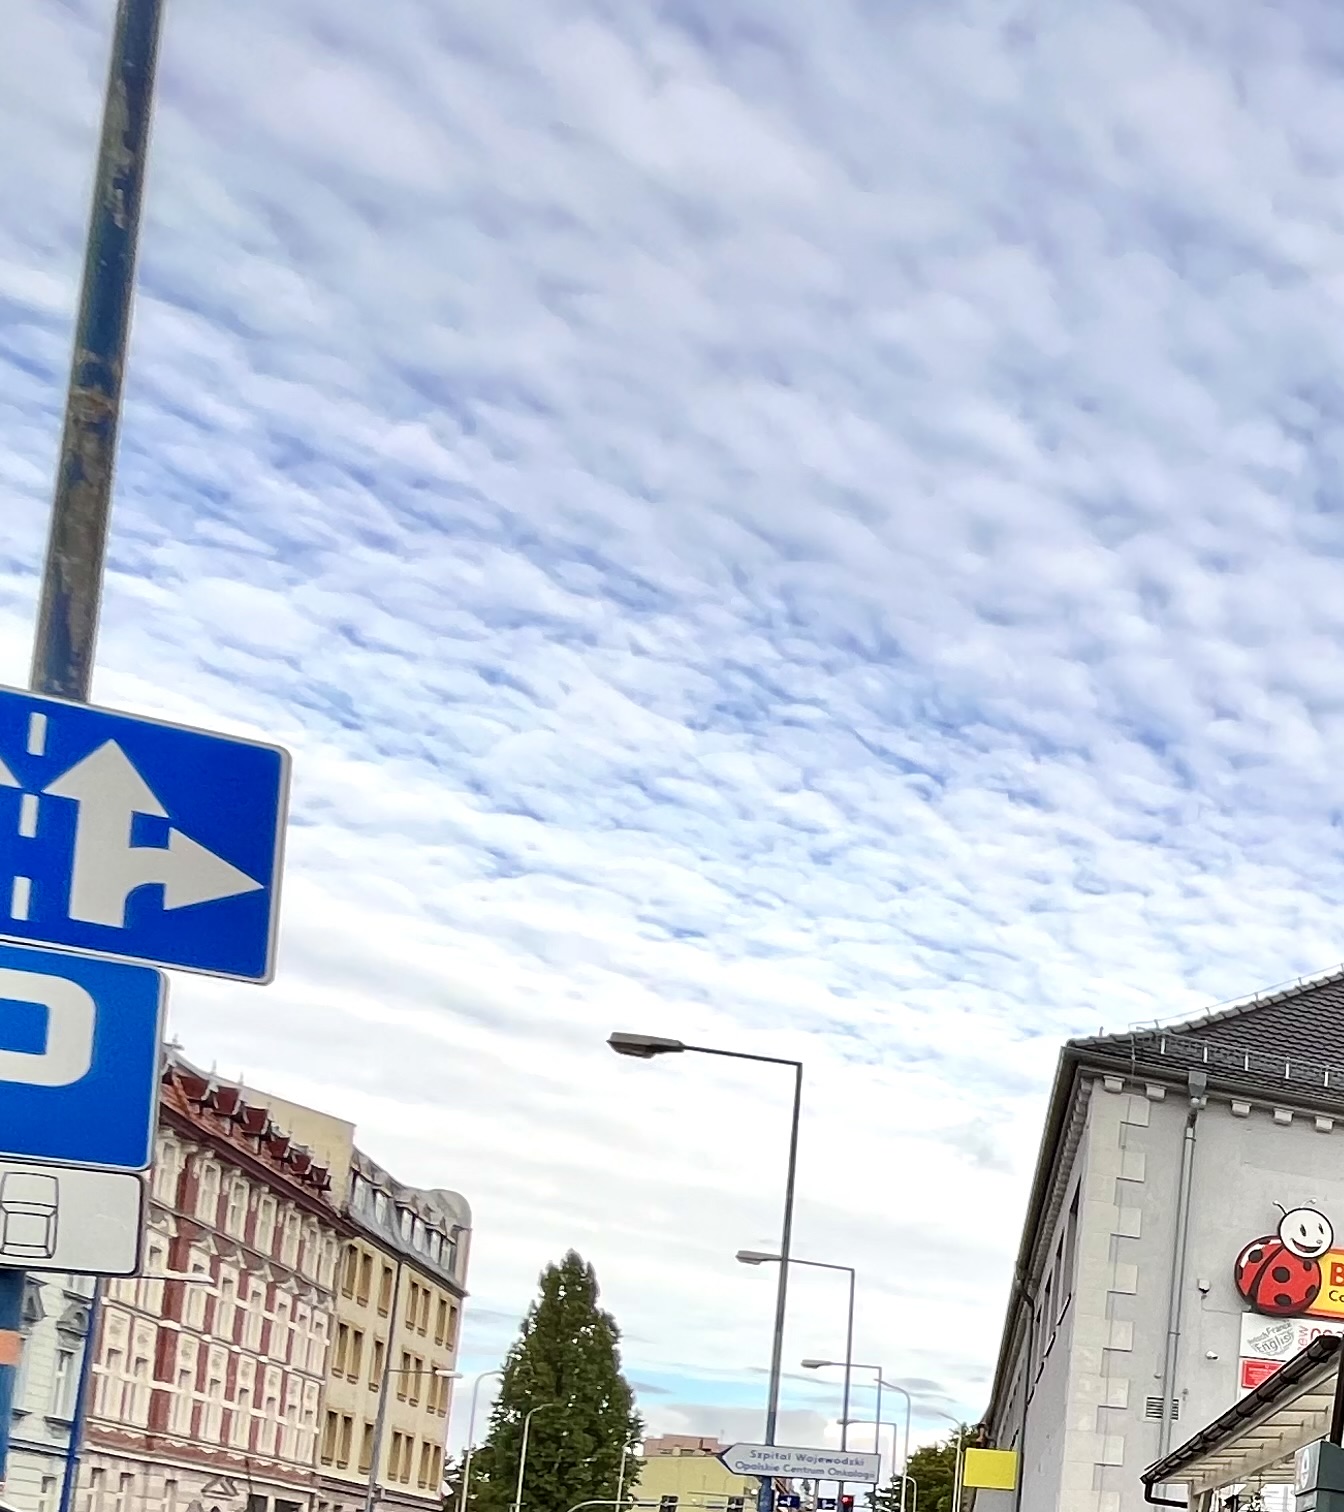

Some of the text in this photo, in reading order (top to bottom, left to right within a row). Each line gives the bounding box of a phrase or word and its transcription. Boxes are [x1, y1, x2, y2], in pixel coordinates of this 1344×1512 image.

[749, 1450, 865, 1466] Szpital Wojewodzki
[735, 1460, 780, 1473] Opolskie
[782, 1464, 825, 1475] Centrum
